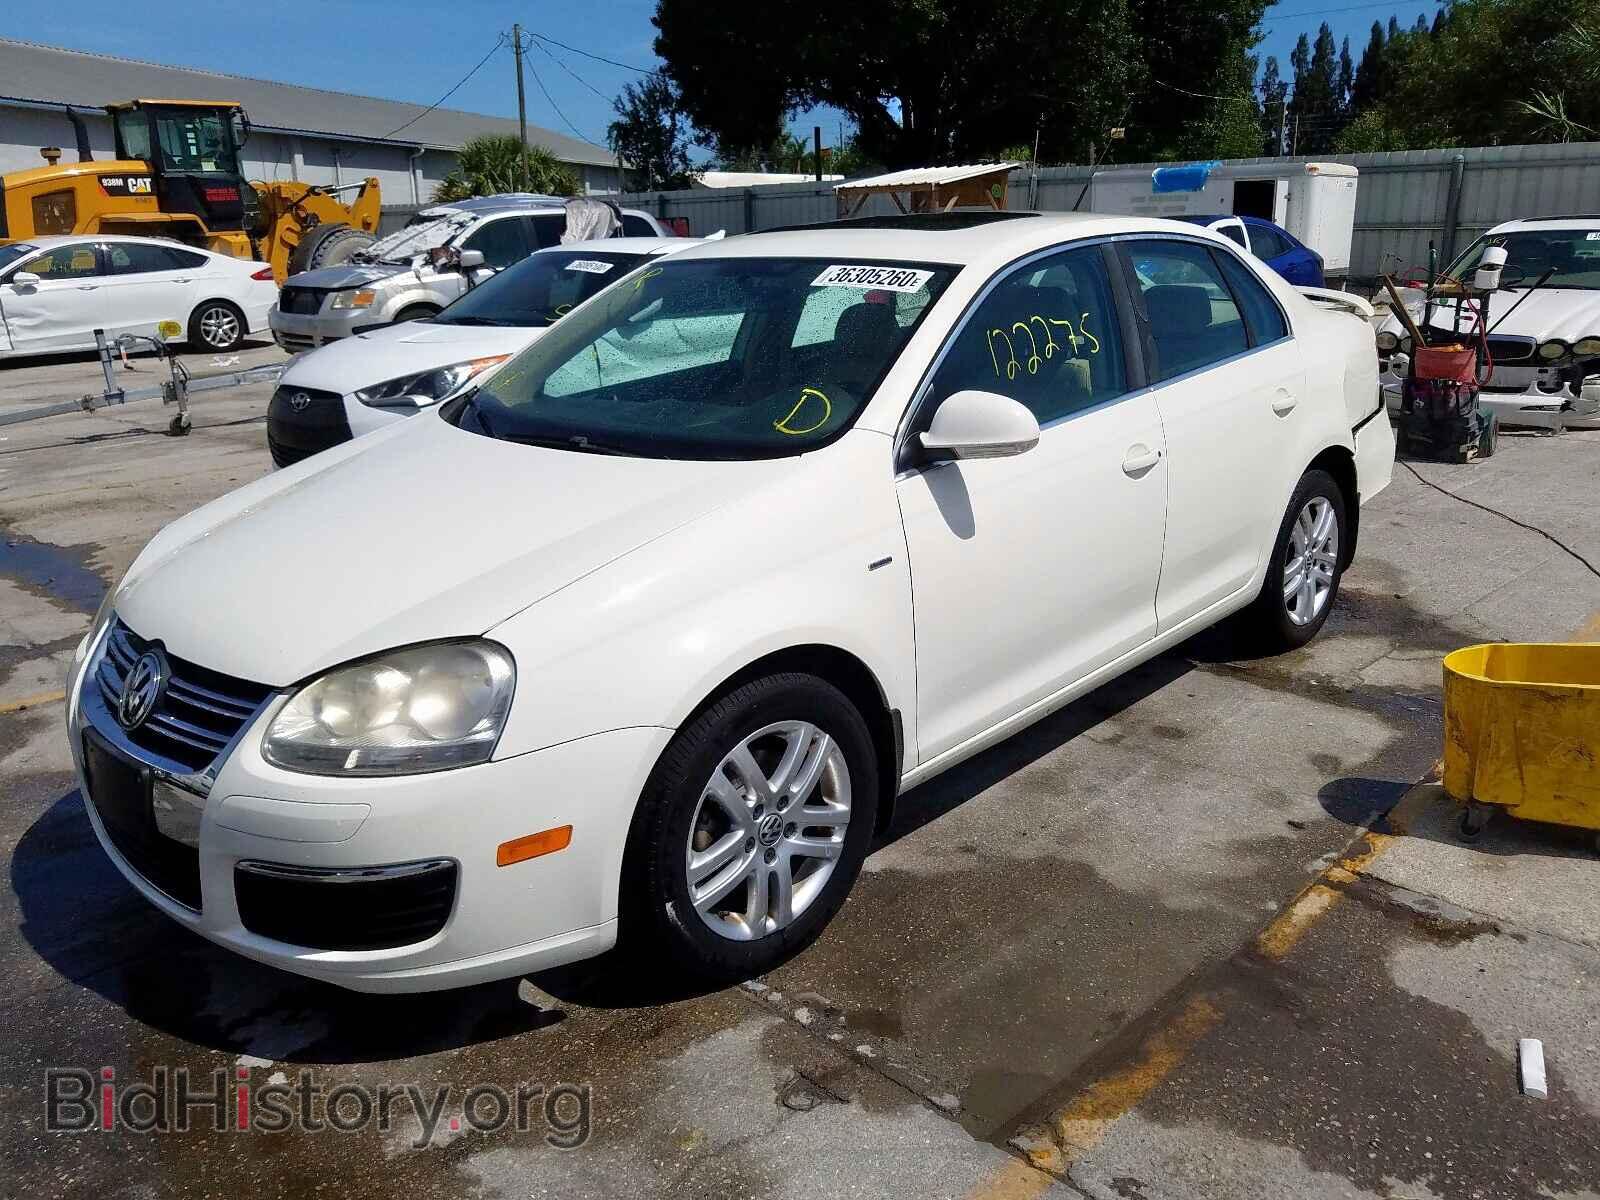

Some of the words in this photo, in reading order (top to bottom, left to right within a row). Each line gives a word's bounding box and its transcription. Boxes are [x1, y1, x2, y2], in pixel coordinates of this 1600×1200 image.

[102, 178, 124, 187] 938M
[127, 178, 152, 193] CAT
[829, 267, 917, 287] 36305260
[986, 312, 1100, 380] 122275
[773, 388, 832, 435] D
